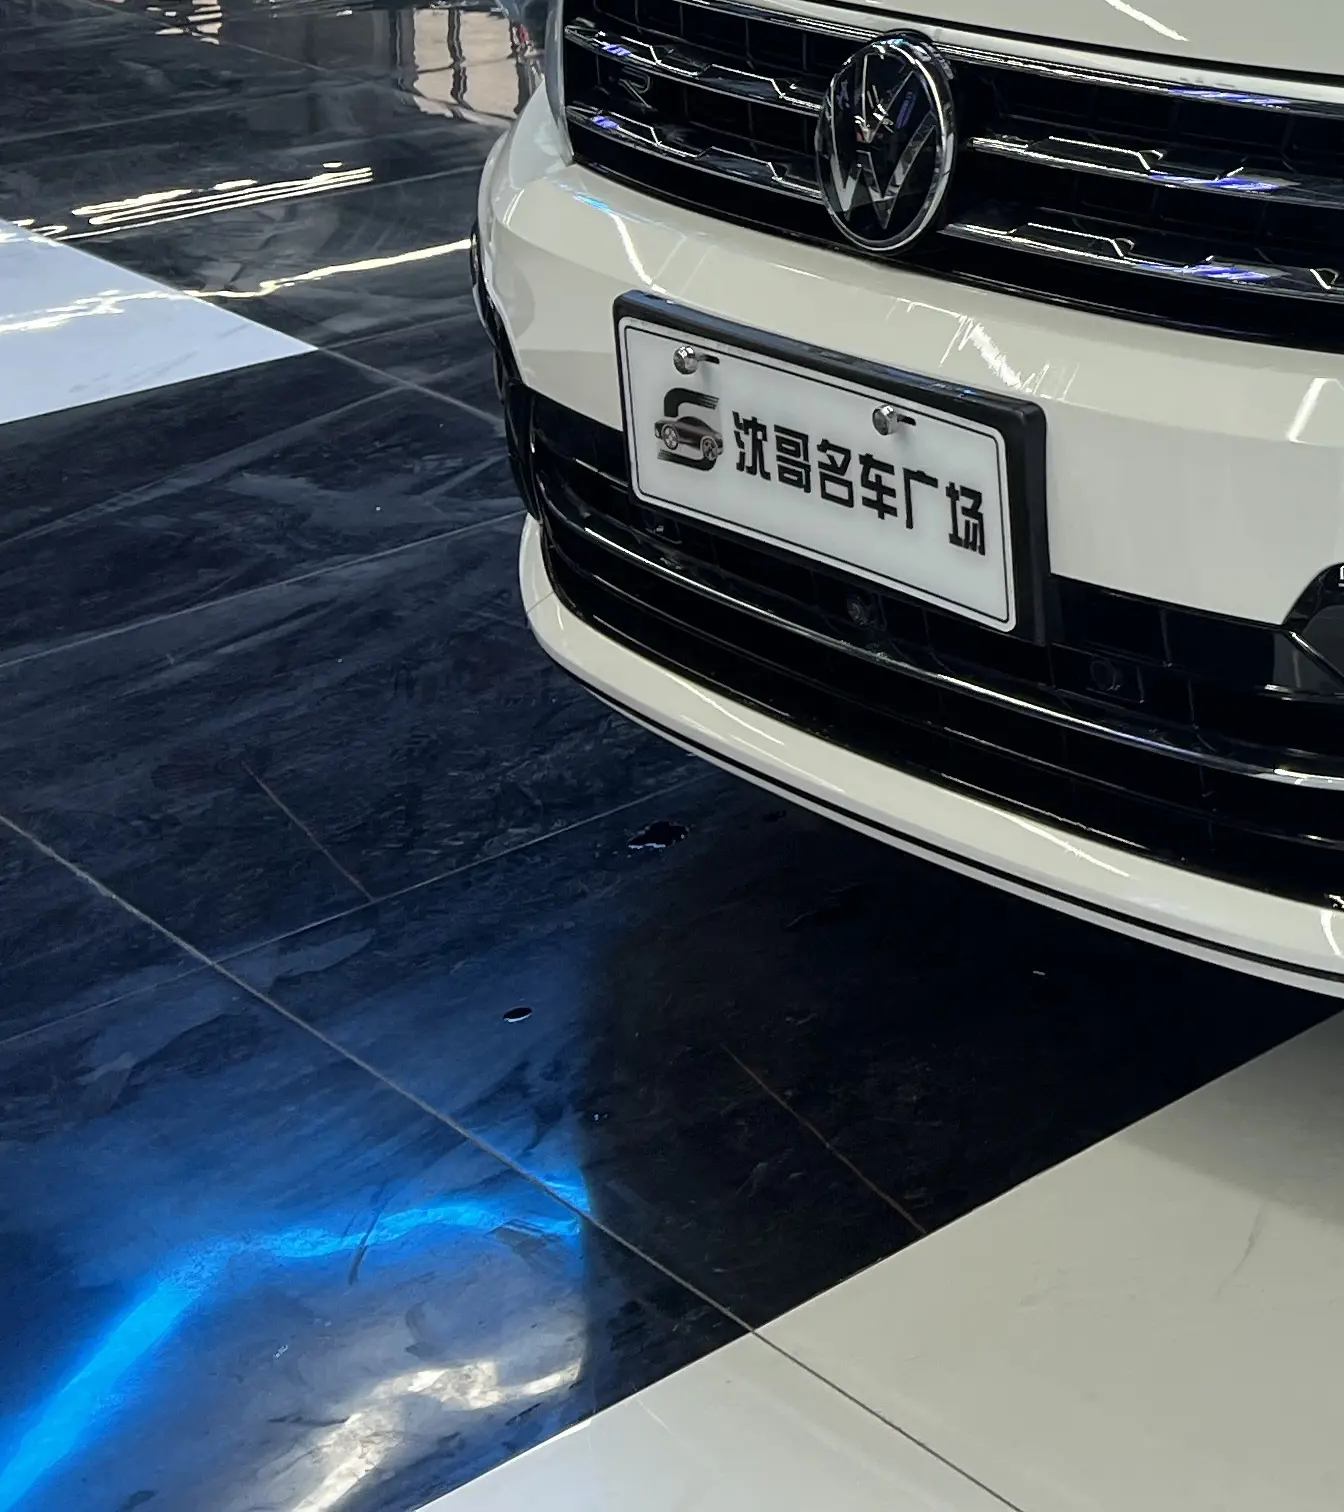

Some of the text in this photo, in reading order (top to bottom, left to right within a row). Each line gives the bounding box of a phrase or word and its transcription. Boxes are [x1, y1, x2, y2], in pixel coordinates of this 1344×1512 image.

[731, 410, 987, 556] 沈哥名车广场
